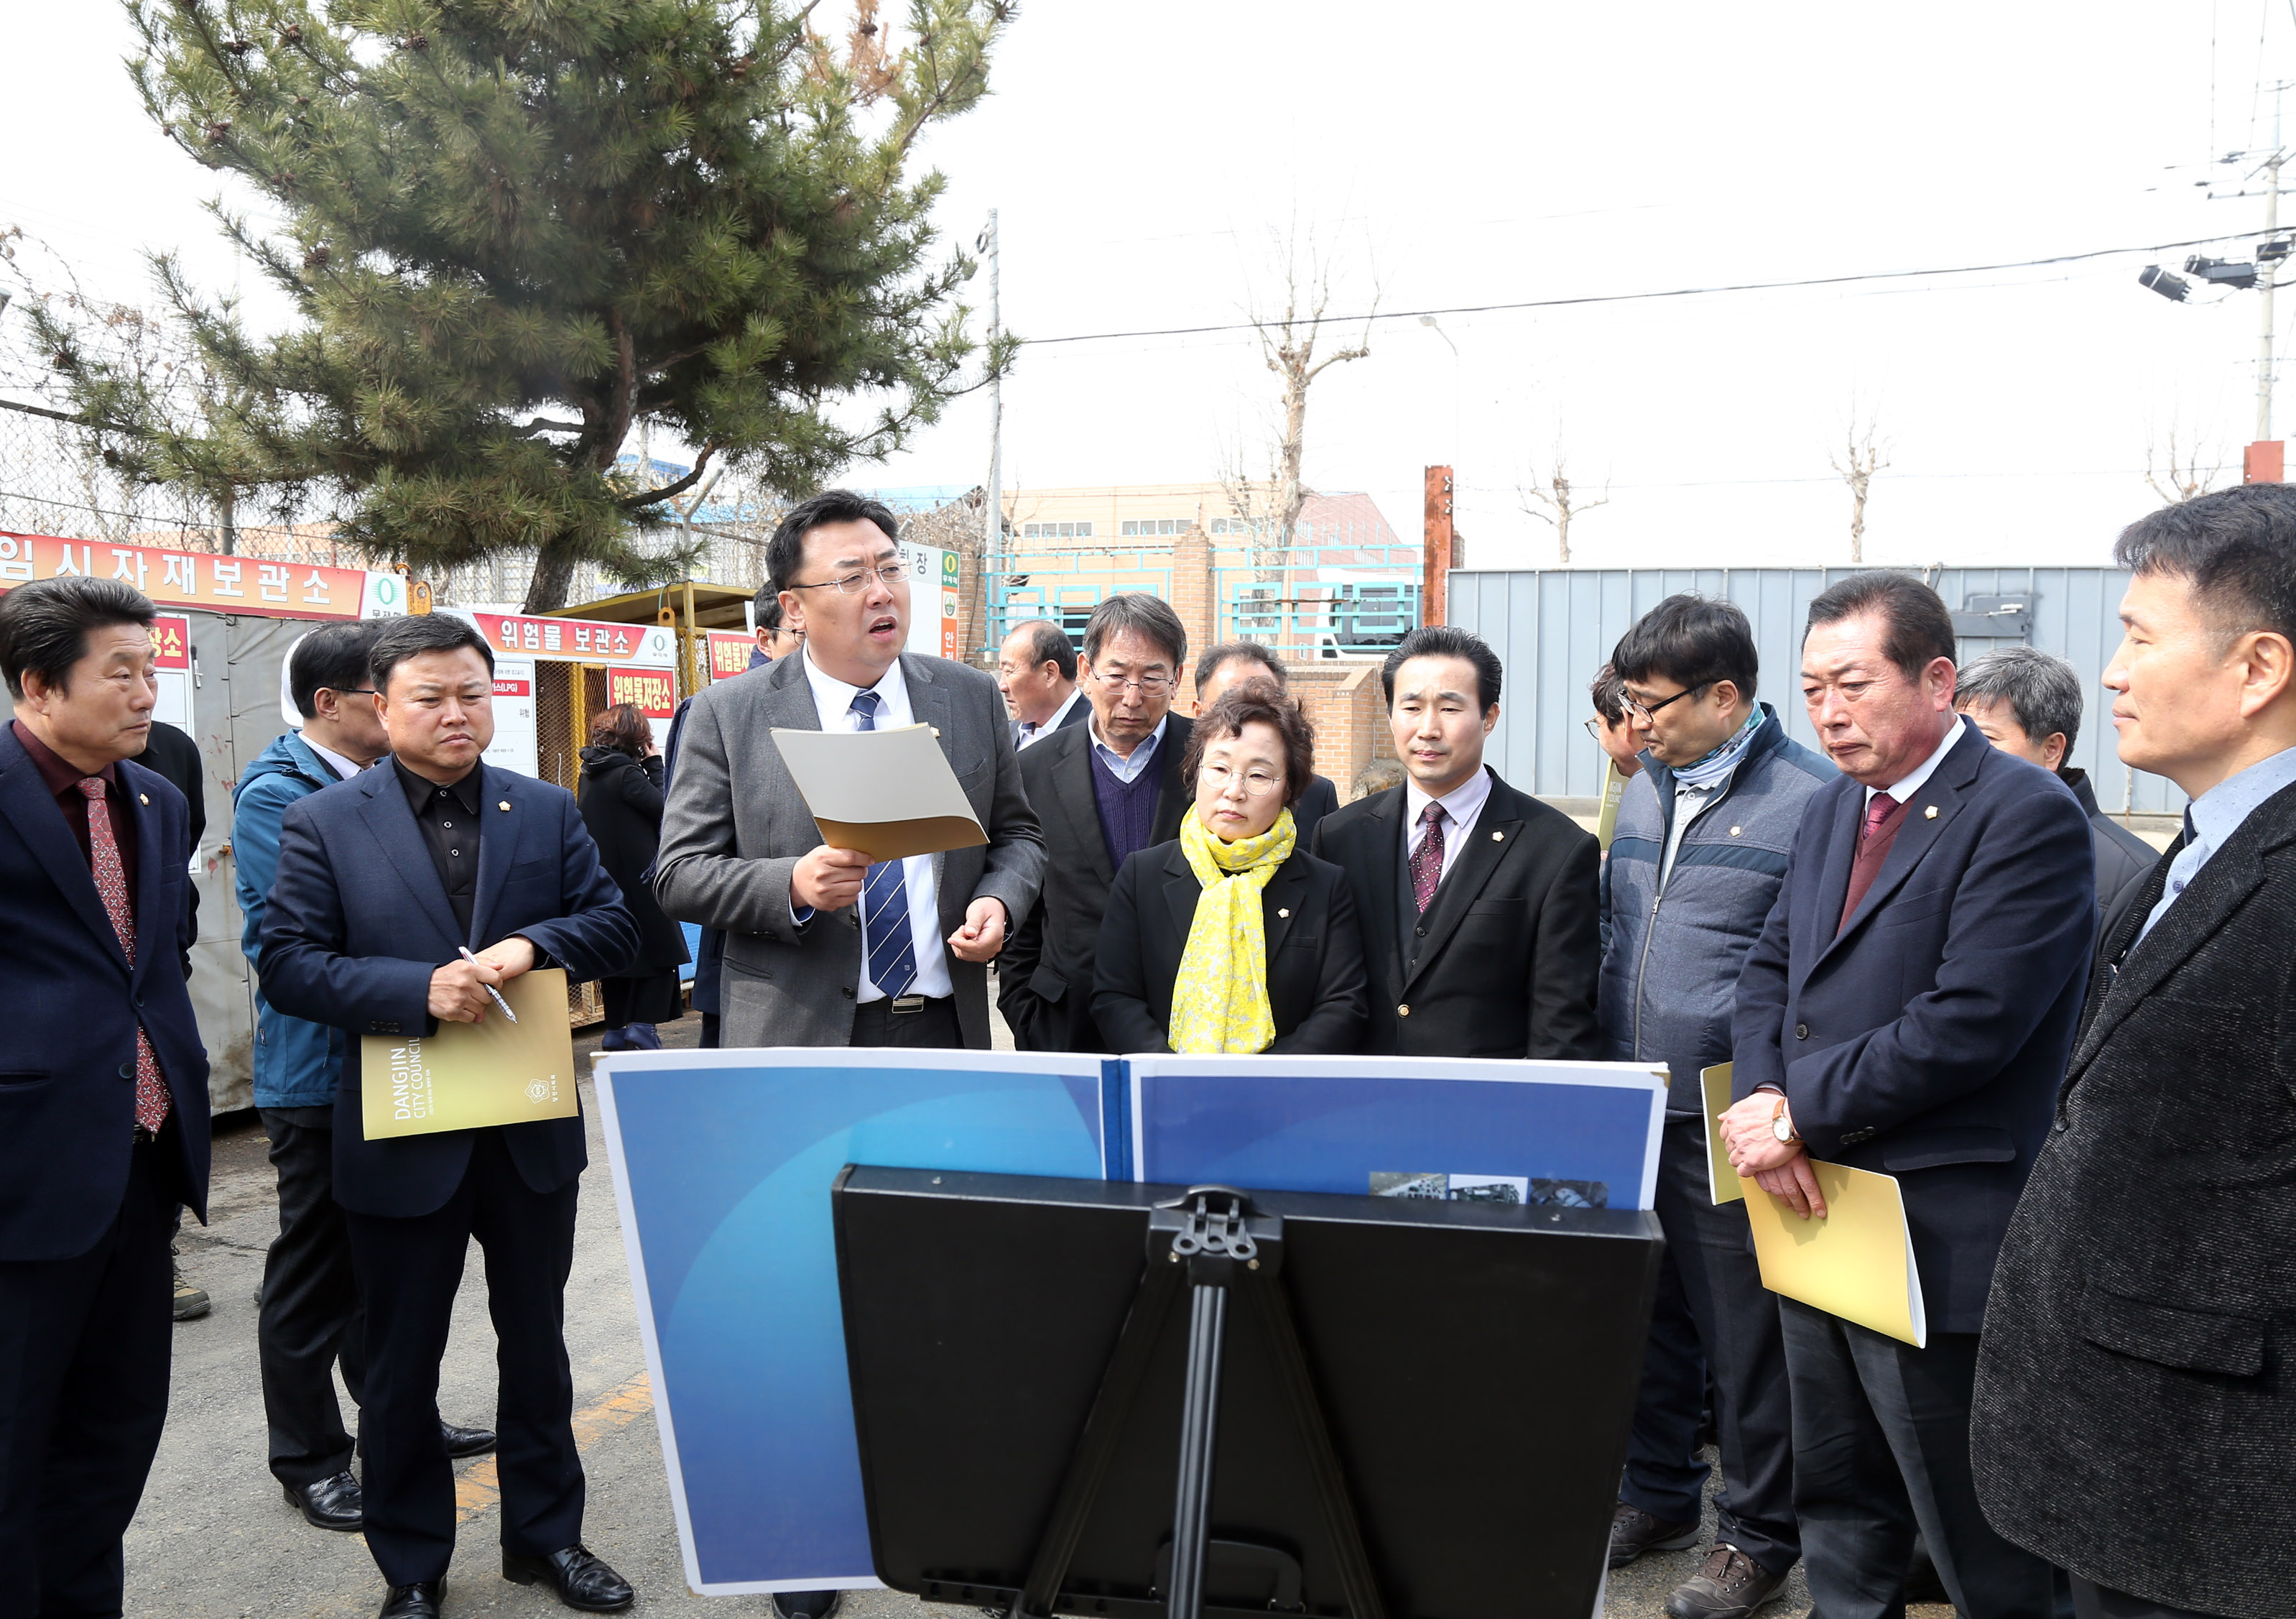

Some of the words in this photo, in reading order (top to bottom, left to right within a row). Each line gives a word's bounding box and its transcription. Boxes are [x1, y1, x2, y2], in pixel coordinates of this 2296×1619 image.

[501, 620, 561, 651] 위험물
[575, 627, 630, 655] 보관소
[614, 675, 671, 711] 위험물저장소
[519, 708, 529, 718] 위험
[408, 1037, 424, 1090] COUNCIL
[390, 1047, 411, 1120] DANGJIN
[412, 1092, 426, 1119] CITY
